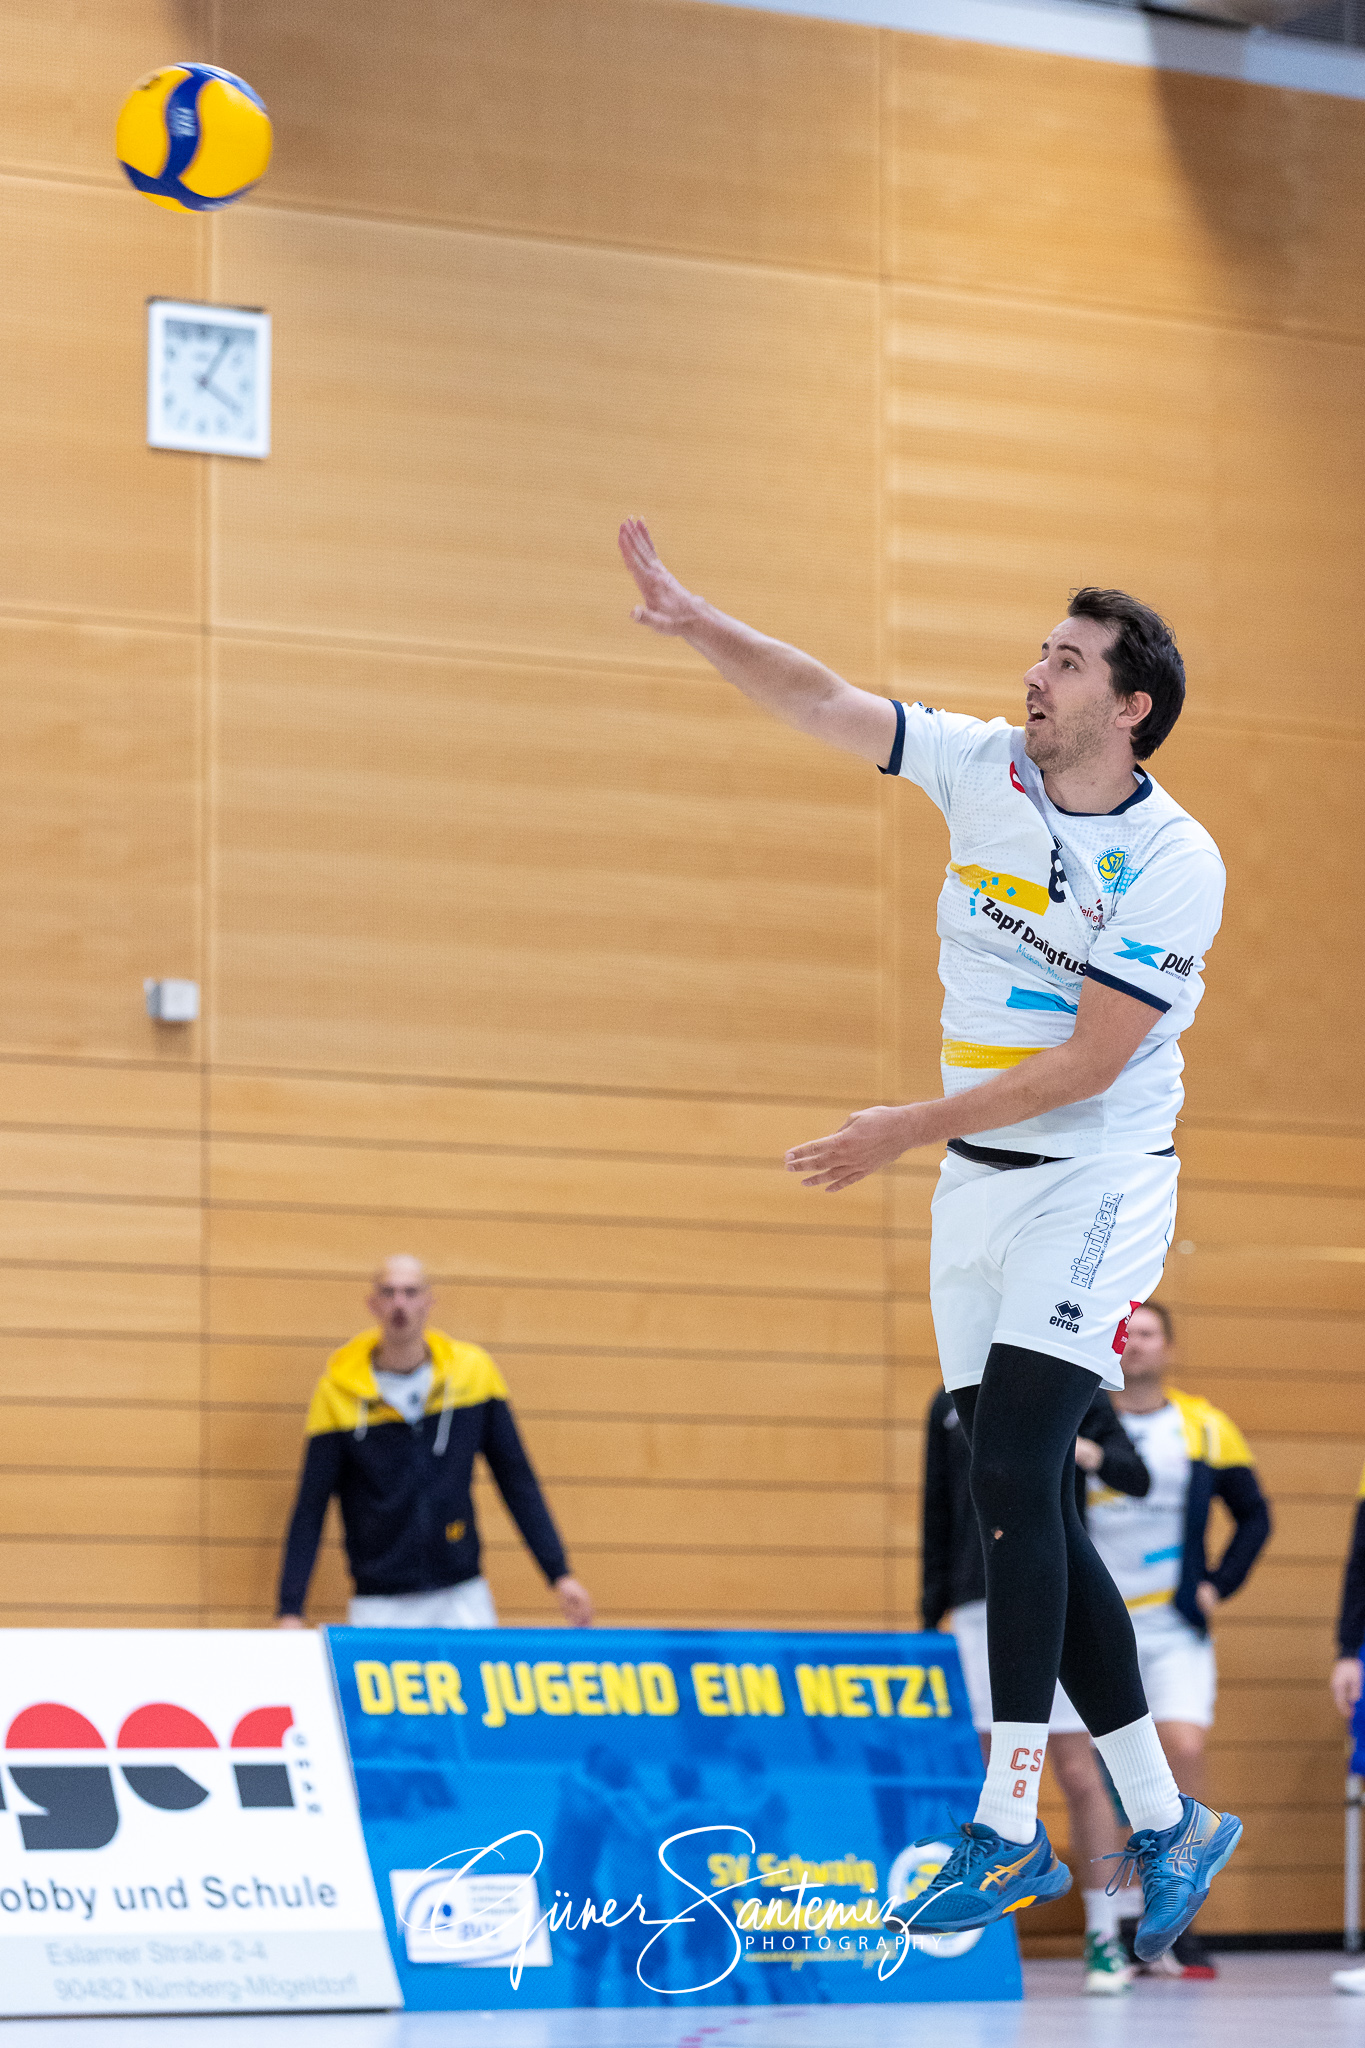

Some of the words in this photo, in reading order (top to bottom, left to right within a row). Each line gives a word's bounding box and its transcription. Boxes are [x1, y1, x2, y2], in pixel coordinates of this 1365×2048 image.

[981, 897, 1025, 935] Zapf
[1021, 926, 1089, 977] Daigfus
[1159, 952, 1194, 977] puls
[1049, 1315, 1080, 1334] errea
[353, 1660, 468, 1716] DER
[480, 1661, 680, 1728] JUGEND
[690, 1662, 785, 1717] EIN
[794, 1663, 952, 1718] NETZ!
[1010, 1747, 1043, 1772] CS
[1012, 1779, 1027, 1798] 8
[112, 1878, 190, 1911] und
[201, 1875, 338, 1910] Schule
